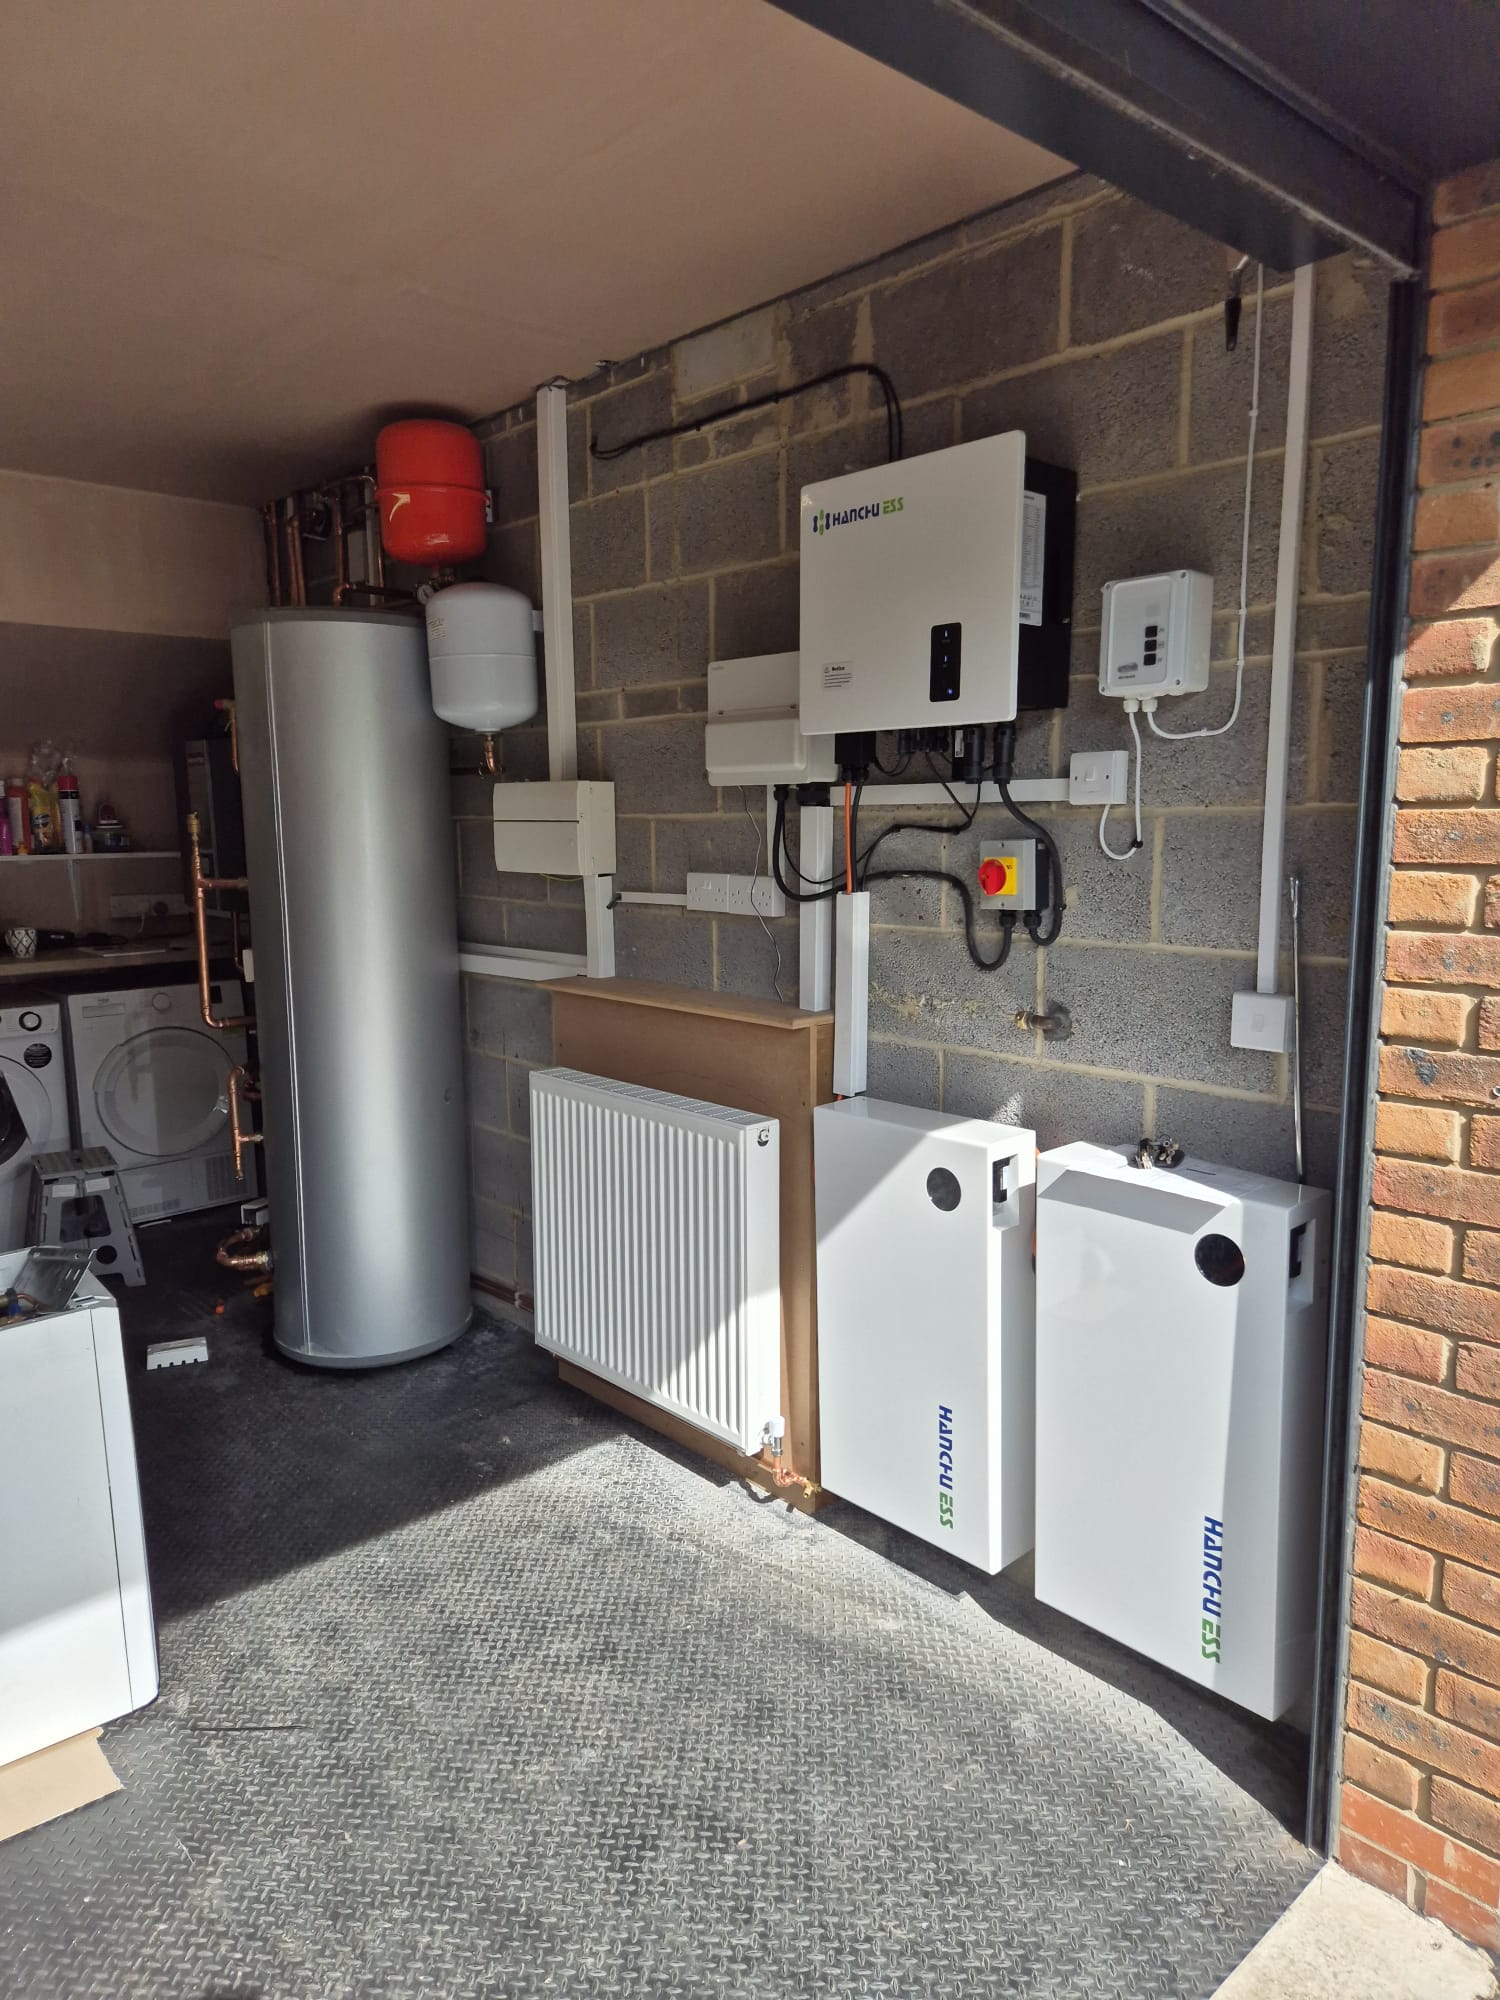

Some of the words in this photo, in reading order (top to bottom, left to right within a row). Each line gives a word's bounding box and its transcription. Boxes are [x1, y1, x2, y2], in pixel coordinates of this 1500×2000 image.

[832, 503, 880, 526] HANCHU
[882, 497, 904, 514] ESS
[939, 1405, 953, 1490] HANCHU
[940, 1491, 953, 1529] ESS
[1202, 1516, 1224, 1618] HANCHU
[1201, 1618, 1221, 1664] ESS
